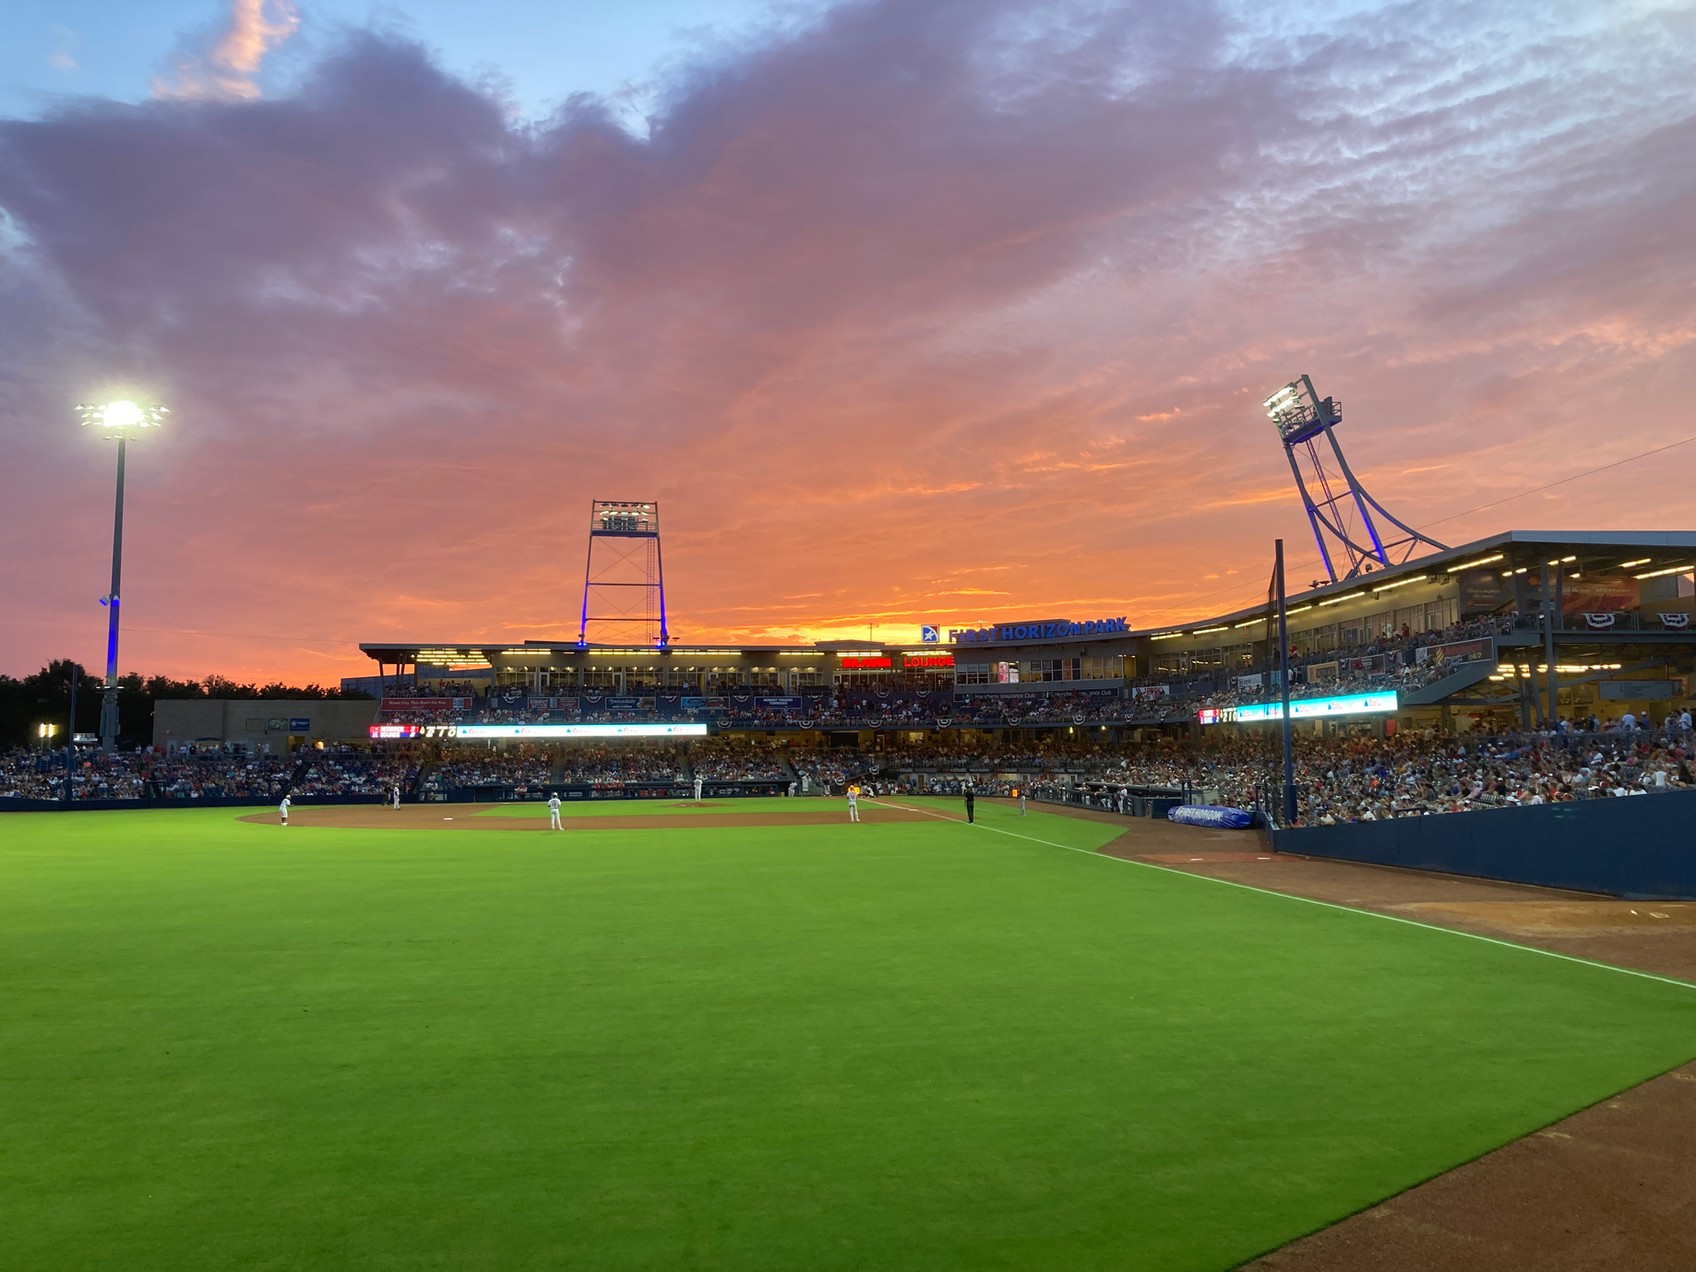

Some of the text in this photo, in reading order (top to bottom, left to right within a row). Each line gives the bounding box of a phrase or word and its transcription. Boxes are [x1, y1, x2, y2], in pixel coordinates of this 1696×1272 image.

[948, 615, 1128, 643] FIRST HORIZON PARK
[904, 656, 956, 667] LOUNGE
